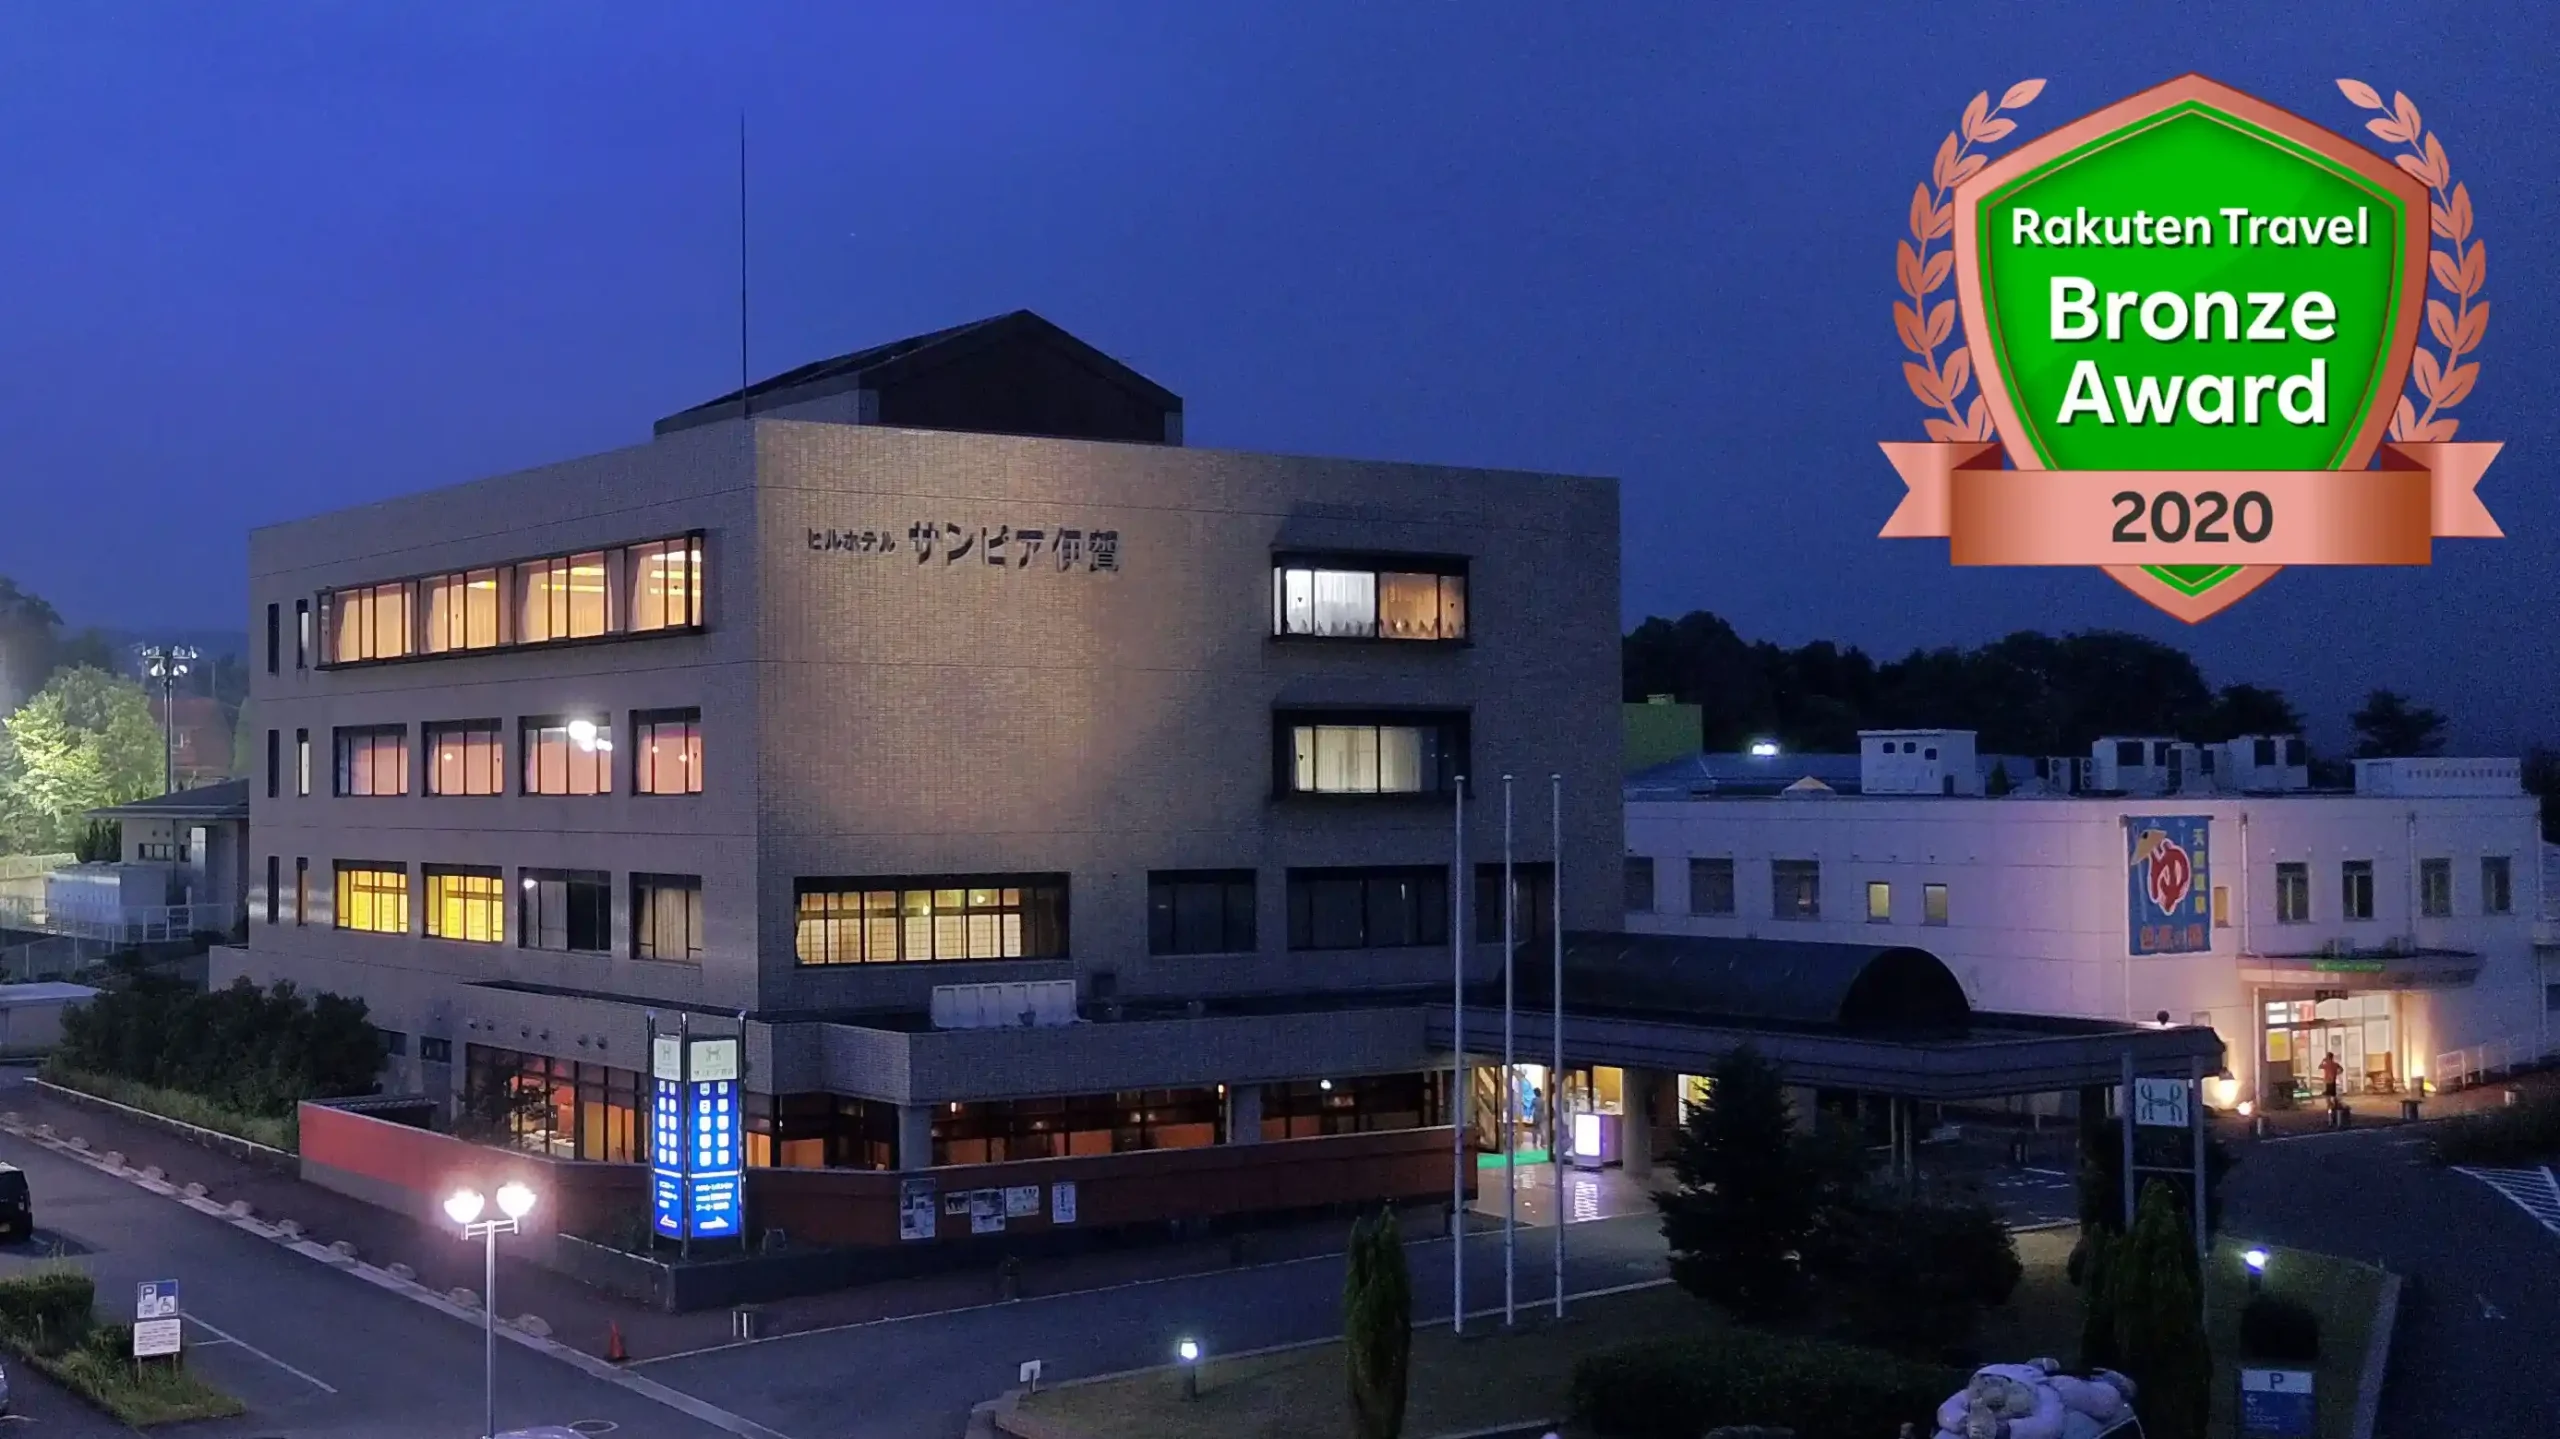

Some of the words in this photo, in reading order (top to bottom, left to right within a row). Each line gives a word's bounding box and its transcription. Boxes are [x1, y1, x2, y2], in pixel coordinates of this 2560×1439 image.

[808, 528, 895, 553] ヒルホテル
[908, 520, 1119, 572] サンピア伊賀
[143, 1286, 155, 1301] P
[2269, 1373, 2284, 1390] P
